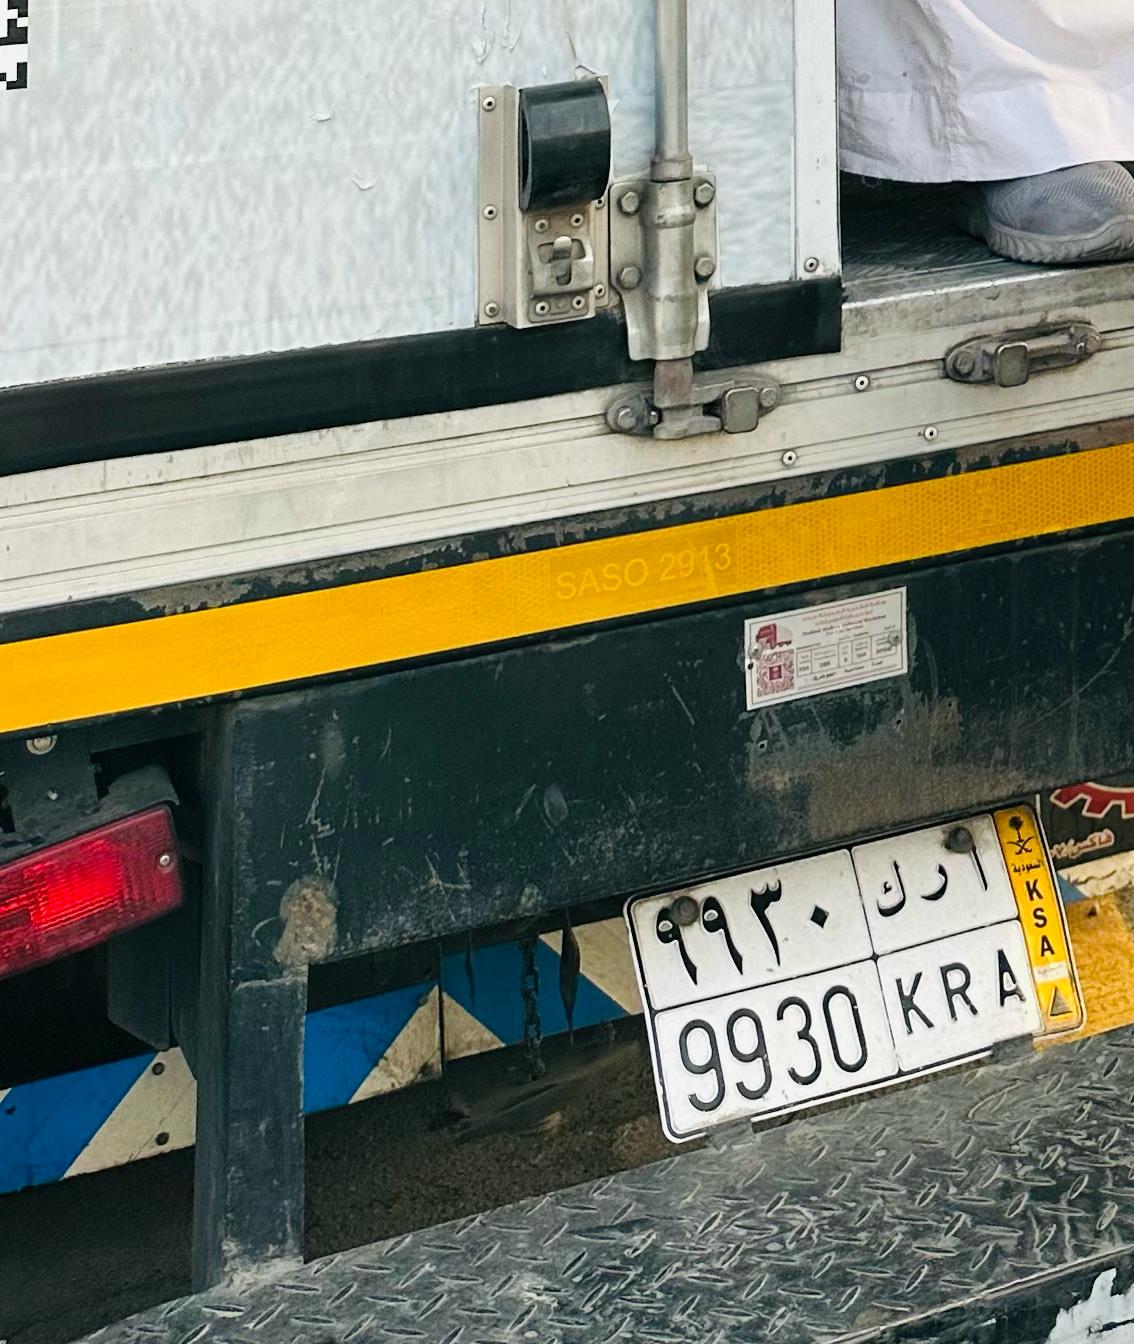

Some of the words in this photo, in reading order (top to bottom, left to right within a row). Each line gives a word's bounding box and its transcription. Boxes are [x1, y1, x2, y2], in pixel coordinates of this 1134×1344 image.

[555, 557, 649, 600] SASO
[659, 543, 731, 582] 2913
[679, 985, 869, 1112] 9930
[895, 948, 1026, 1036] KRA
